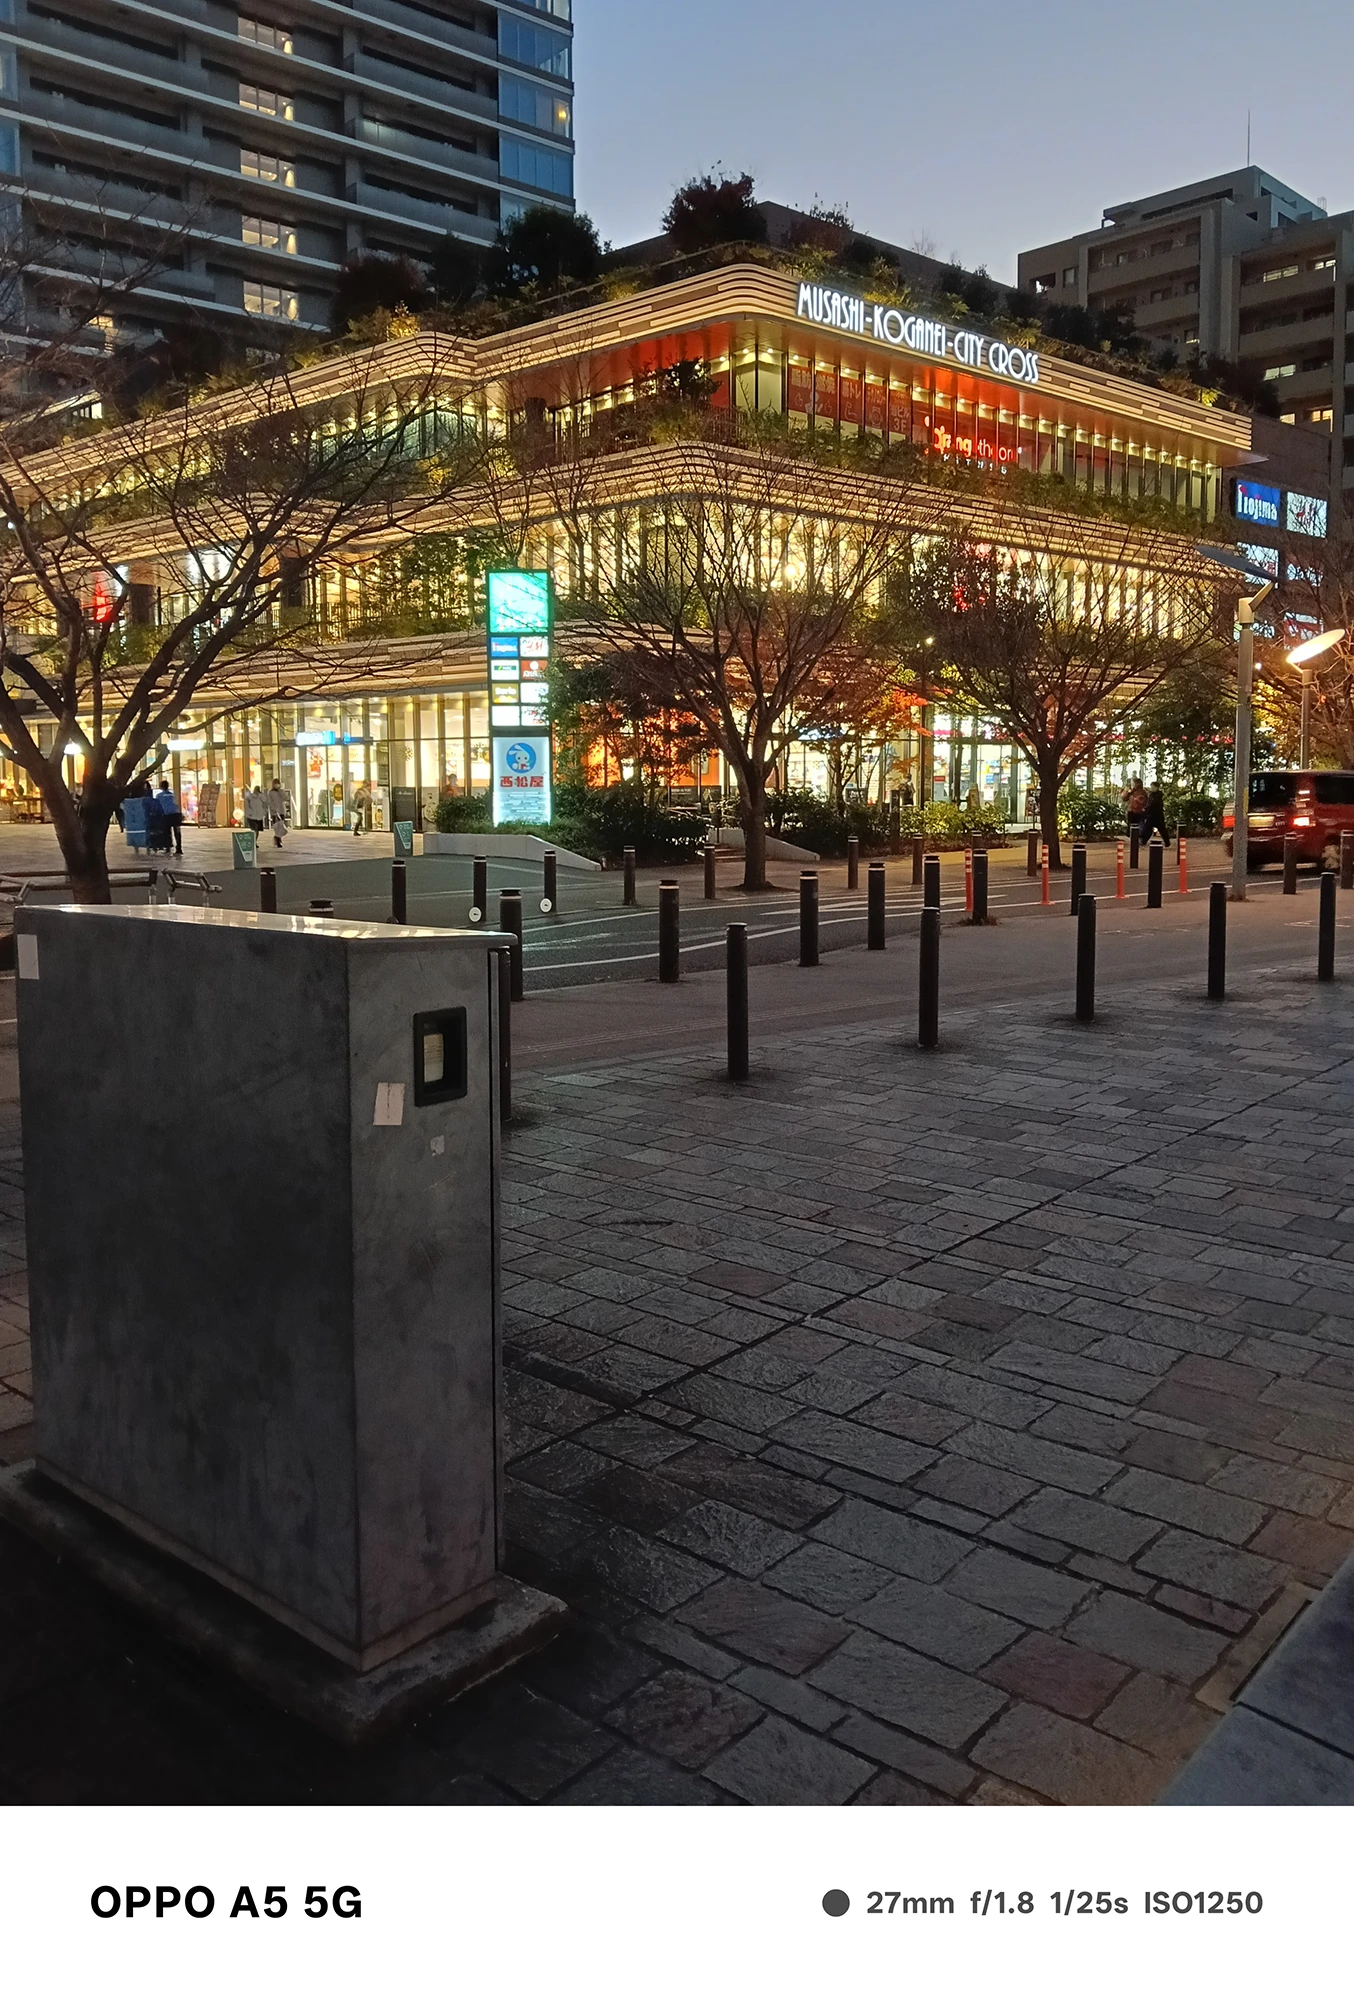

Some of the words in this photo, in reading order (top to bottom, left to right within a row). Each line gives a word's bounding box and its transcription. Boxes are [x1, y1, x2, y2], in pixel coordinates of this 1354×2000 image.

[988, 342, 1039, 384] CROSS
[893, 418, 906, 432] 3F
[500, 775, 544, 788] 西松屋
